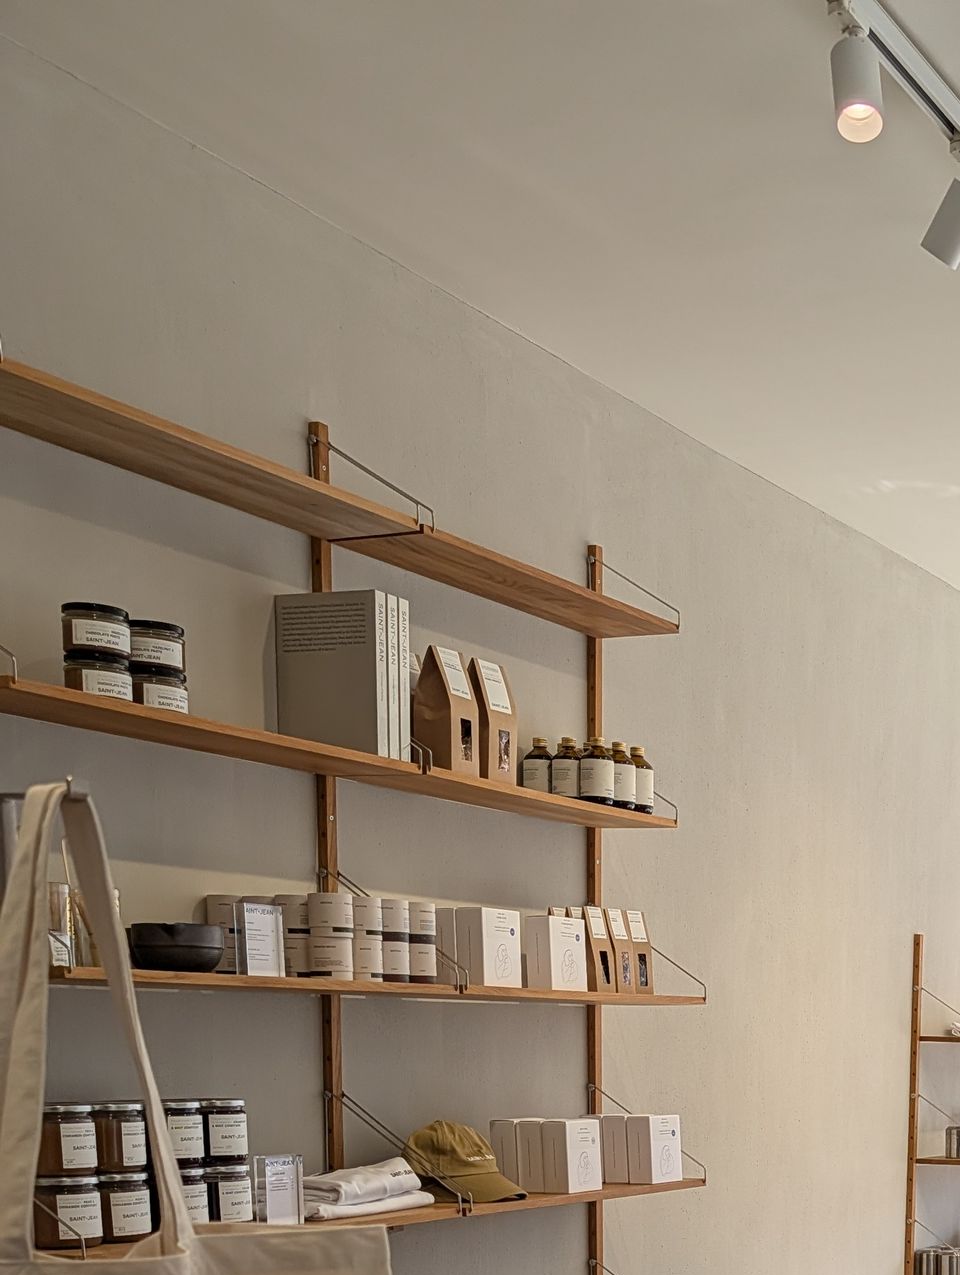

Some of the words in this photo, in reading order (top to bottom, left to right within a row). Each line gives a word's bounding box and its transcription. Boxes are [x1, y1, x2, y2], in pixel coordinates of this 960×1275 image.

[86, 637, 120, 646] SAINT-JEAN
[131, 653, 161, 661] AINT-JEAN
[246, 908, 274, 916] AINT-JEAN
